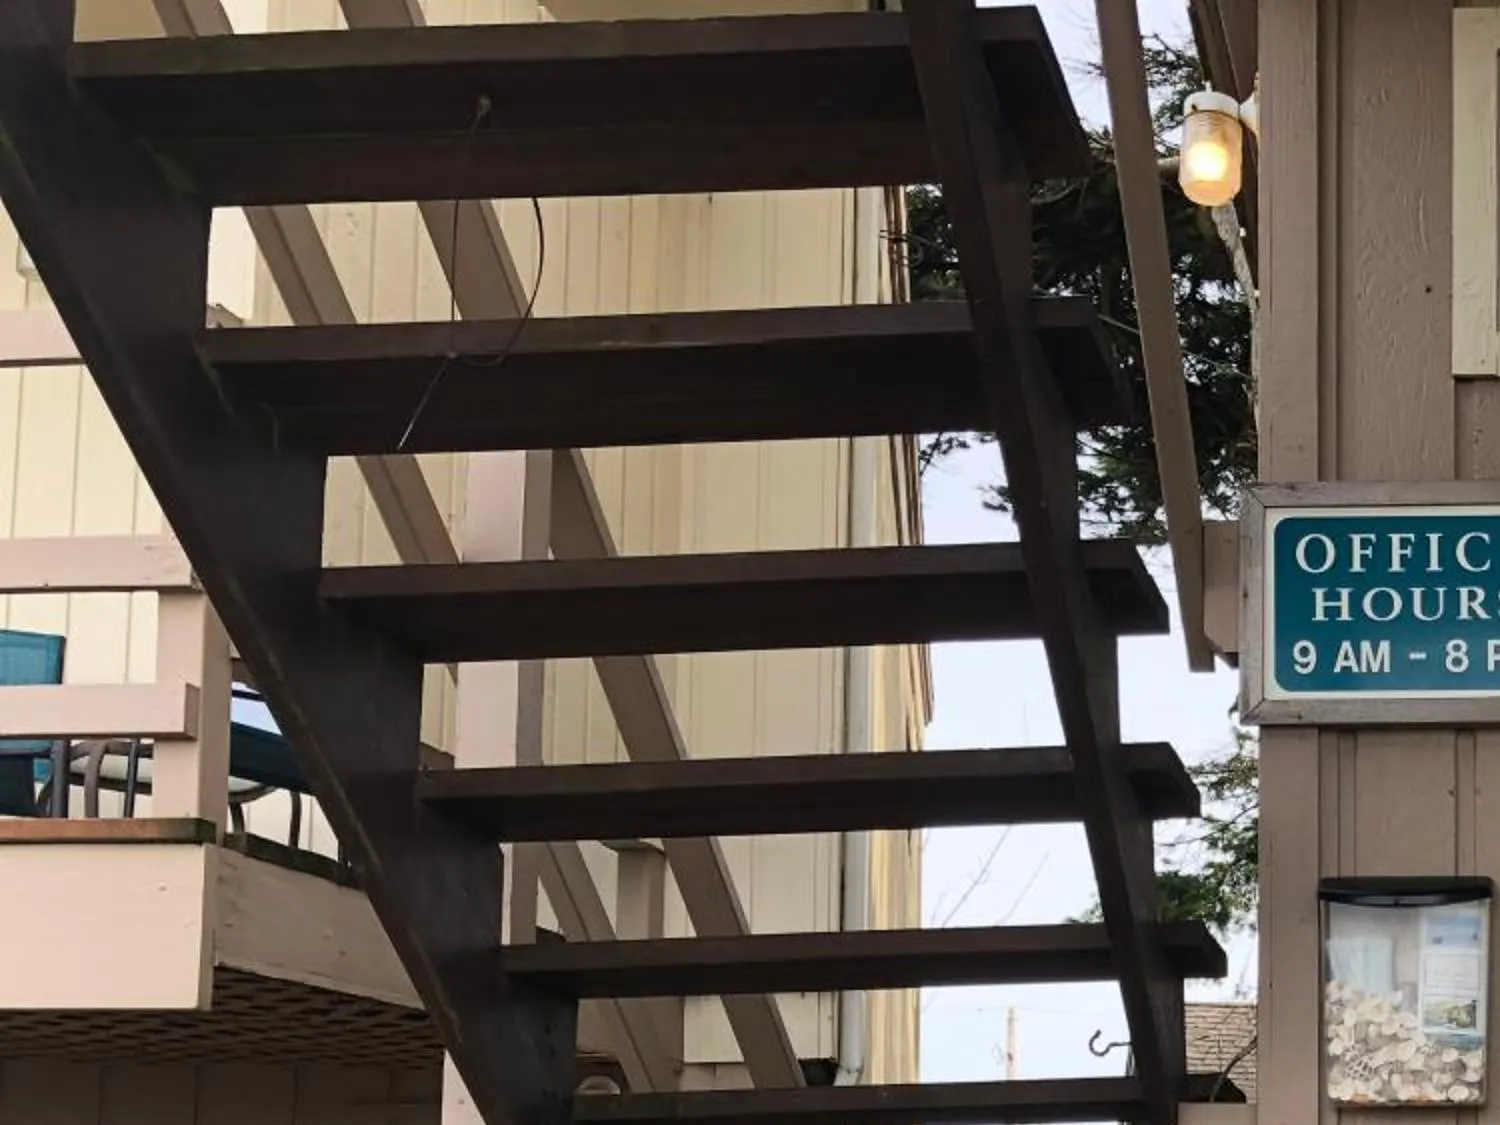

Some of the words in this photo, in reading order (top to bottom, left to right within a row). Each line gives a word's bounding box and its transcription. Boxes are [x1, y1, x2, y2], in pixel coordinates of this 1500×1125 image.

[1293, 640, 1317, 675] 9
[1333, 640, 1391, 673] AM
[1445, 639, 1469, 673] 8
